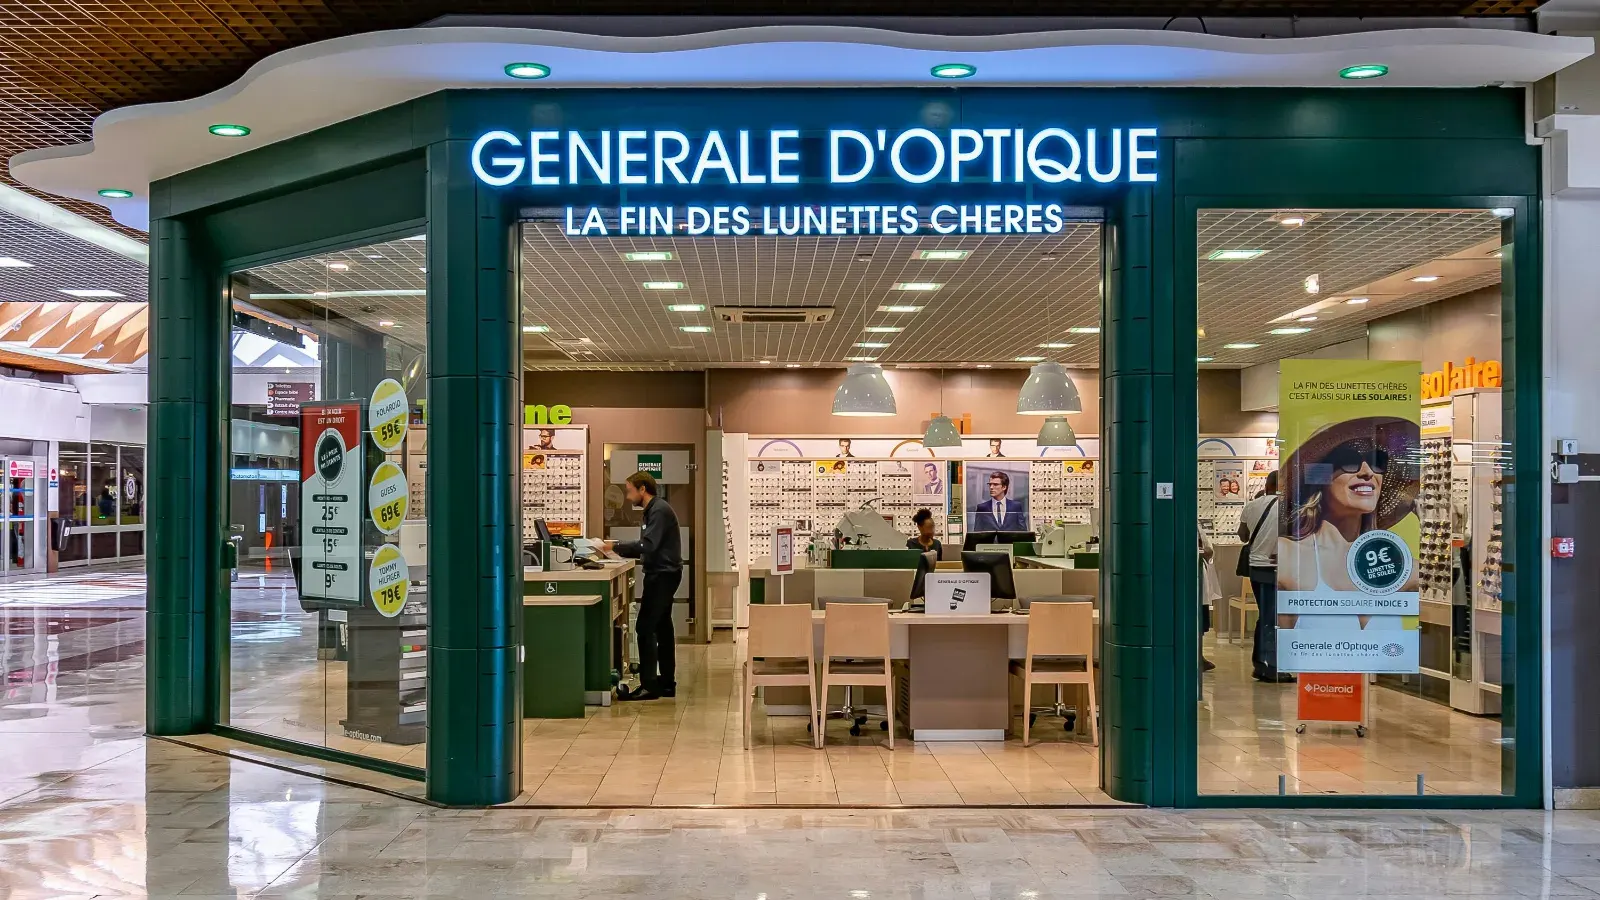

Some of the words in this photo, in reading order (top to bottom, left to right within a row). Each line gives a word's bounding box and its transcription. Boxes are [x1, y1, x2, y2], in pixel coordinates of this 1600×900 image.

[471, 130, 799, 186] GENERALE
[830, 128, 1158, 184] D'OPTIQUE
[566, 206, 608, 236] LA
[620, 206, 673, 235] FIN
[687, 206, 750, 236] DES
[763, 205, 919, 235] LUNETTES
[930, 204, 1063, 235] CHERES
[1421, 356, 1502, 400] solaire
[1336, 382, 1376, 390] LUNETTES
[1377, 381, 1408, 391] CHÈRES
[1289, 392, 1309, 400] C'EST
[381, 419, 401, 441] 59€
[380, 484, 397, 498] GUESS
[321, 505, 339, 521] 25€
[381, 502, 401, 522] 69€
[1365, 547, 1391, 567] 9€
[379, 562, 397, 576] TOMMY
[1366, 563, 1396, 574] LUNETTES
[1376, 569, 1397, 578] SOLEIL
[378, 570, 401, 585] HILFIGER
[381, 585, 401, 605] 79€
[1288, 599, 1339, 607] PROTECTION
[1340, 599, 1373, 607] SOLAIRE
[1374, 599, 1402, 608] INDICE
[1403, 600, 1409, 608] 3
[1291, 641, 1333, 650] Generale
[1335, 641, 1379, 652] d'Optique
[1313, 684, 1354, 694] Polaroid
